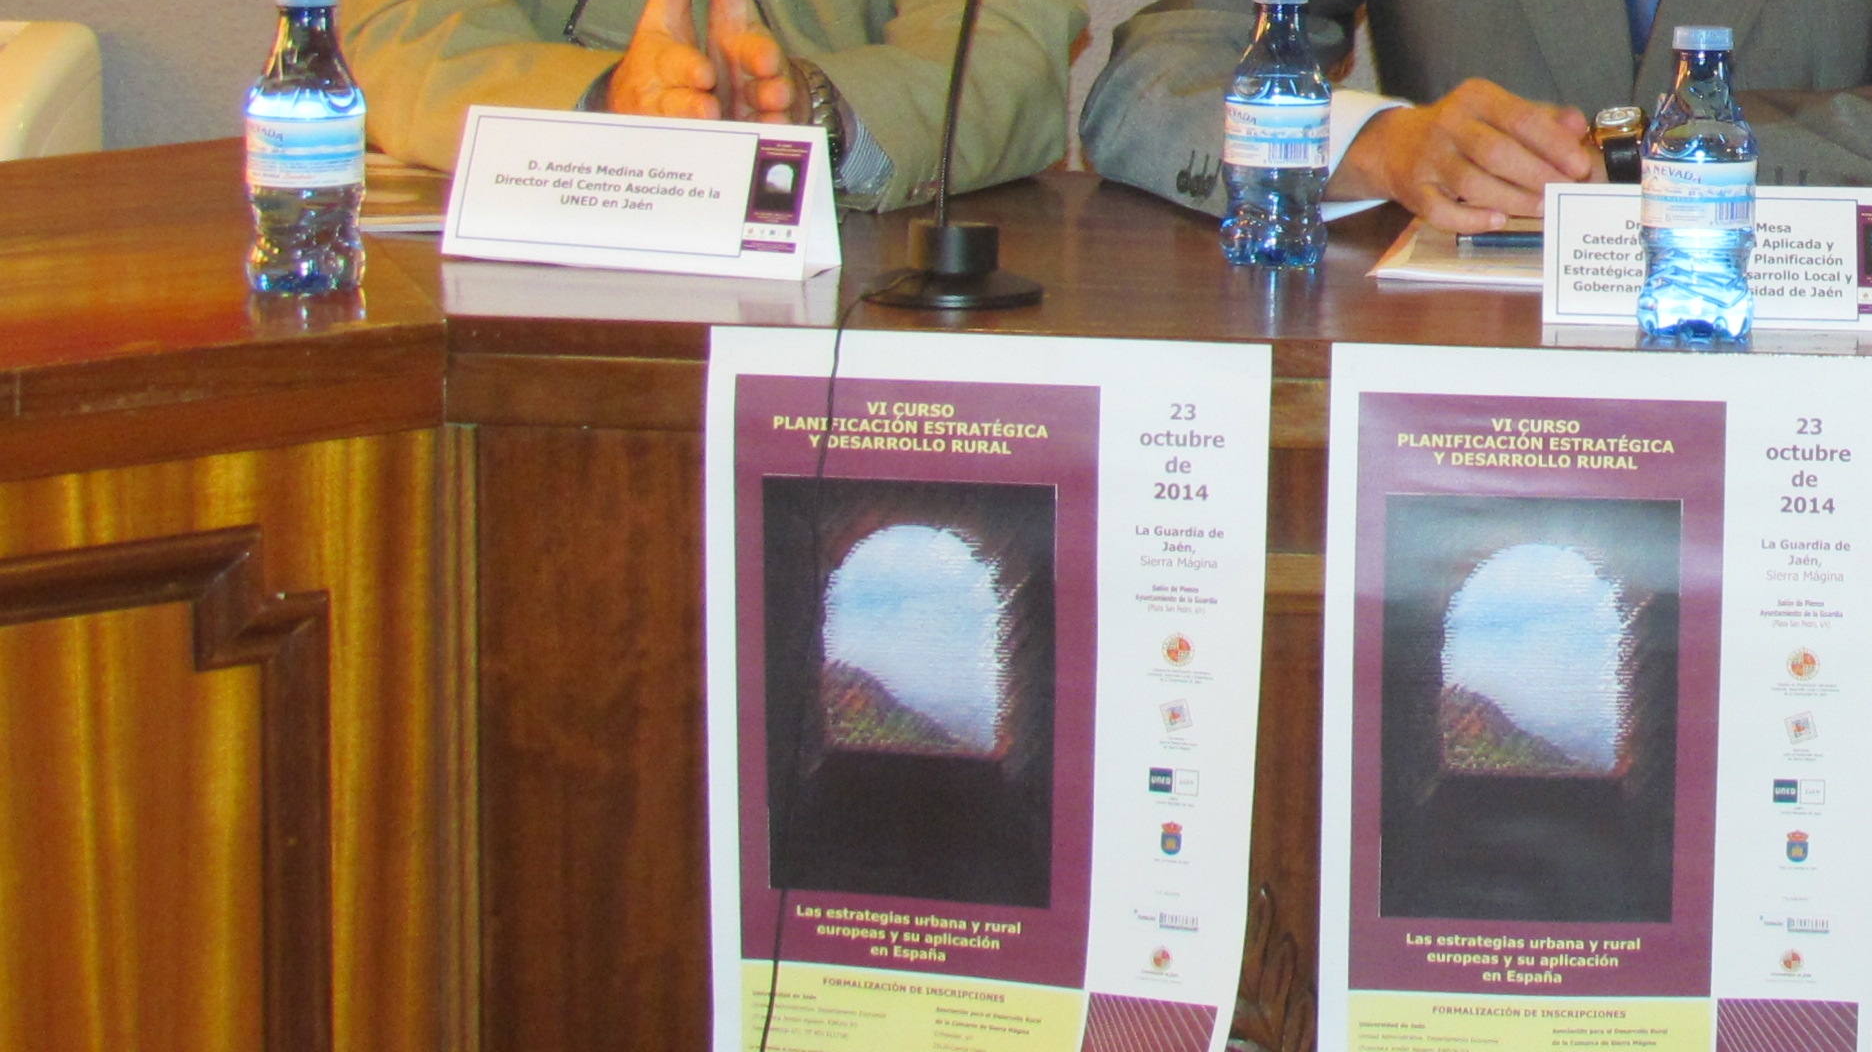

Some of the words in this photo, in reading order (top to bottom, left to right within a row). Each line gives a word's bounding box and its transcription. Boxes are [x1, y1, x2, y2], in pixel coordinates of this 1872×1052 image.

[528, 160, 542, 170] D.
[545, 161, 592, 175] Andrés
[597, 164, 643, 178] Medina
[648, 168, 693, 181] Gómez
[495, 174, 549, 188] Director
[553, 178, 572, 189] del
[577, 179, 621, 192] Centro
[625, 182, 684, 196] Asociado
[688, 187, 705, 197] de
[709, 188, 720, 199] la
[560, 195, 598, 206] UNED
[602, 198, 618, 209] en
[622, 199, 653, 210] Jaén
[1757, 223, 1791, 233] Mesa
[1763, 239, 1821, 250] Aplicada
[1826, 242, 1834, 251] y
[1573, 249, 1630, 260] Director
[1755, 254, 1843, 265] Planificación
[1564, 265, 1643, 278] Estratégica
[1746, 270, 1799, 280] sarrollo
[1805, 271, 1840, 281] Local
[1845, 274, 1852, 284] y
[1573, 281, 1641, 292] Gobernan
[1789, 287, 1806, 296] de
[1810, 287, 1842, 297] Jaén
[867, 402, 887, 415] VI
[893, 403, 955, 418] CURSO
[1170, 403, 1196, 421] 23
[924, 419, 1048, 438] ESTRATÉGICA
[1492, 418, 1512, 432] VI
[1518, 419, 1580, 434] CURSO
[1797, 418, 1823, 435] 23
[809, 434, 821, 447] Y
[827, 435, 945, 452] DESARROLLO
[951, 439, 1012, 454] RURAL
[1140, 430, 1225, 448] octubre
[1398, 433, 1544, 450] PLANIFICACIÓN
[1550, 435, 1674, 454] ESTRATÉGICA
[1434, 452, 1445, 465] Y
[1452, 452, 1571, 468] DESARROLLO
[1577, 456, 1638, 470] RURAL
[1766, 444, 1851, 462] octubre
[1165, 456, 1191, 474] de
[1792, 470, 1818, 487] de
[1154, 482, 1209, 501] 2014
[1780, 496, 1835, 514] 2014
[1135, 525, 1149, 535] La
[1154, 526, 1204, 538] Guardia
[1209, 529, 1224, 538] de
[1162, 541, 1195, 554] Jaén,
[1761, 539, 1776, 549] La
[1780, 539, 1830, 551] Guardia
[1835, 540, 1851, 551] de
[1788, 554, 1822, 568] Jaén,
[797, 905, 822, 918] Las
[826, 908, 910, 925] estrategias
[915, 914, 966, 930] urbana
[971, 920, 980, 934] y
[985, 922, 1022, 934] rural
[817, 924, 885, 941] europeas
[890, 930, 899, 943] y
[903, 932, 920, 943] su
[924, 932, 1000, 950] aplicación
[1406, 933, 1432, 945] Las
[1437, 933, 1525, 950] estrategias
[1530, 936, 1584, 950] urbana
[1590, 939, 1598, 951] y
[1604, 938, 1641, 950] rural
[871, 945, 888, 956] en
[893, 946, 946, 962] España
[1427, 951, 1498, 966] europeas
[1504, 955, 1513, 967] y
[1518, 955, 1535, 966] su
[1540, 954, 1619, 968] aplicación
[1483, 971, 1501, 981] en
[1507, 970, 1562, 985] España
[823, 977, 906, 993] FORMALIZACIÓN
[910, 986, 922, 994] DE
[927, 987, 1005, 1003] INSCRIPCIONES
[1432, 1005, 1520, 1017] FORMALIZACIÓN
[1524, 1009, 1537, 1017] DE
[1541, 1009, 1626, 1019] INSCRIPCIONES
